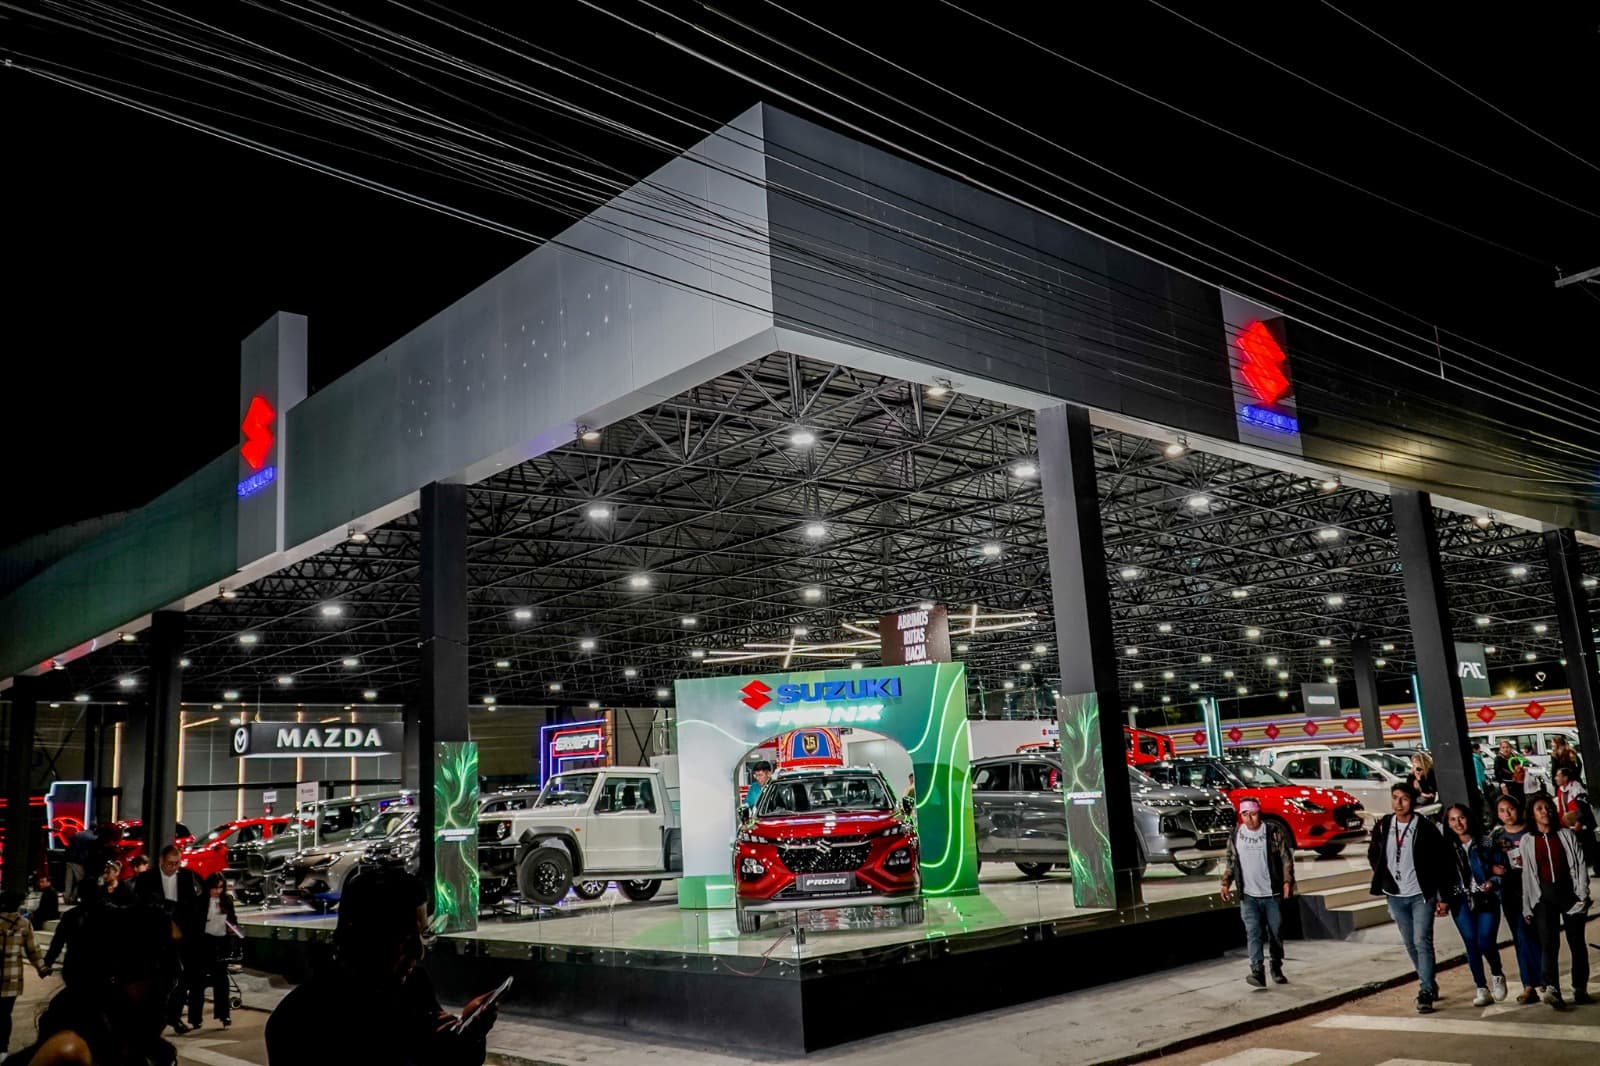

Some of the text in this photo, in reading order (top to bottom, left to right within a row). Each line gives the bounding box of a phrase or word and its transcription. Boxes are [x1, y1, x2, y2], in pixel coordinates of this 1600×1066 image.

[897, 610, 929, 630] ABRIMOS
[903, 628, 926, 646] RUTAS
[904, 644, 927, 662] HACIA
[777, 678, 902, 704] SUZUKI
[756, 705, 883, 727] FRONX
[276, 728, 383, 748] MAZDA
[806, 878, 847, 886] FRONX
